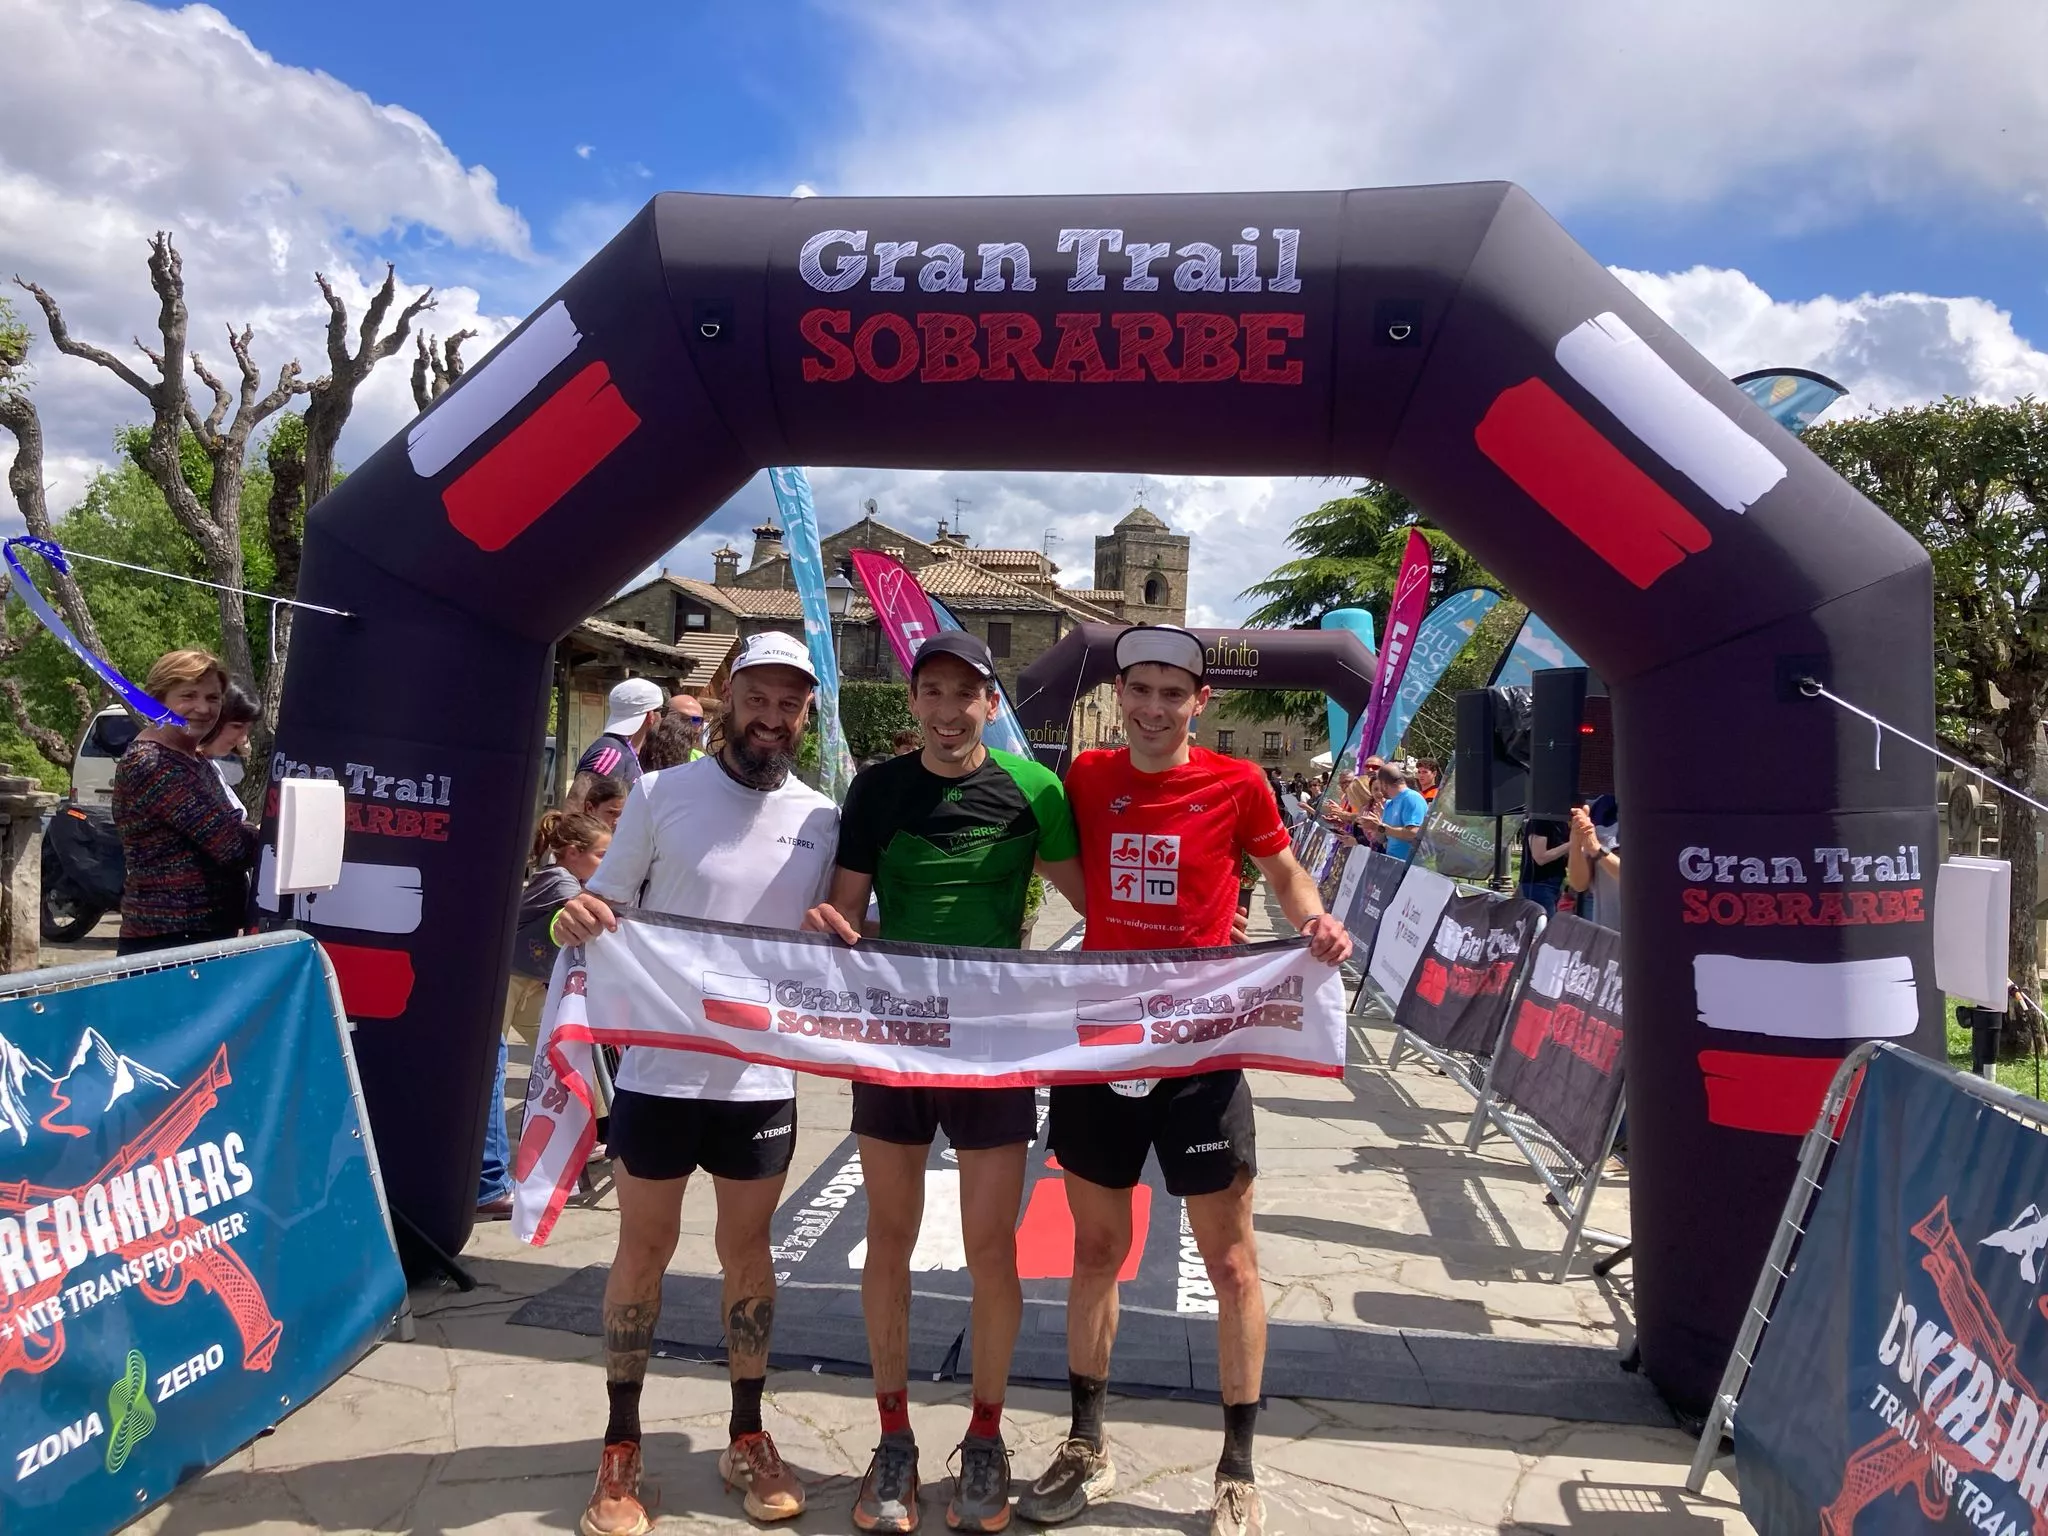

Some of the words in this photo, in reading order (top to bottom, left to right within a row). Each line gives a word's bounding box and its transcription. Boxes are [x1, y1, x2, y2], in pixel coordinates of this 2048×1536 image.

[800, 229, 1037, 293] Gran
[1057, 227, 1302, 293] Trail
[800, 308, 1305, 384] SOBRARBE
[771, 649, 798, 660] TERREX
[1205, 667, 1258, 677] ronometraje
[271, 751, 335, 784] Gran
[346, 762, 451, 806] Trail
[265, 787, 450, 842] SARBE
[787, 836, 815, 850] TERREX
[1441, 819, 1495, 852] TUHUESCA
[1678, 846, 1807, 884] Gran
[1814, 845, 1920, 883] Trail
[1146, 879, 1175, 896] TD
[1681, 887, 1926, 926] SOBRARBE
[775, 979, 861, 1013] Gran
[866, 987, 950, 1019] Trail
[1148, 994, 1235, 1019] Gran
[777, 1009, 951, 1048] SOBRARBE
[1151, 1003, 1304, 1044] SOBRARBE
[763, 1123, 792, 1139] TERREX
[1195, 1140, 1230, 1153] TERREX
[15, 1295, 65, 1338] MTB
[64, 1212, 248, 1314] TRANSFRONTIER
[16, 1411, 105, 1482] ZONA
[157, 1343, 226, 1402] ZERO
[1870, 1384, 1919, 1450] TRAIL
